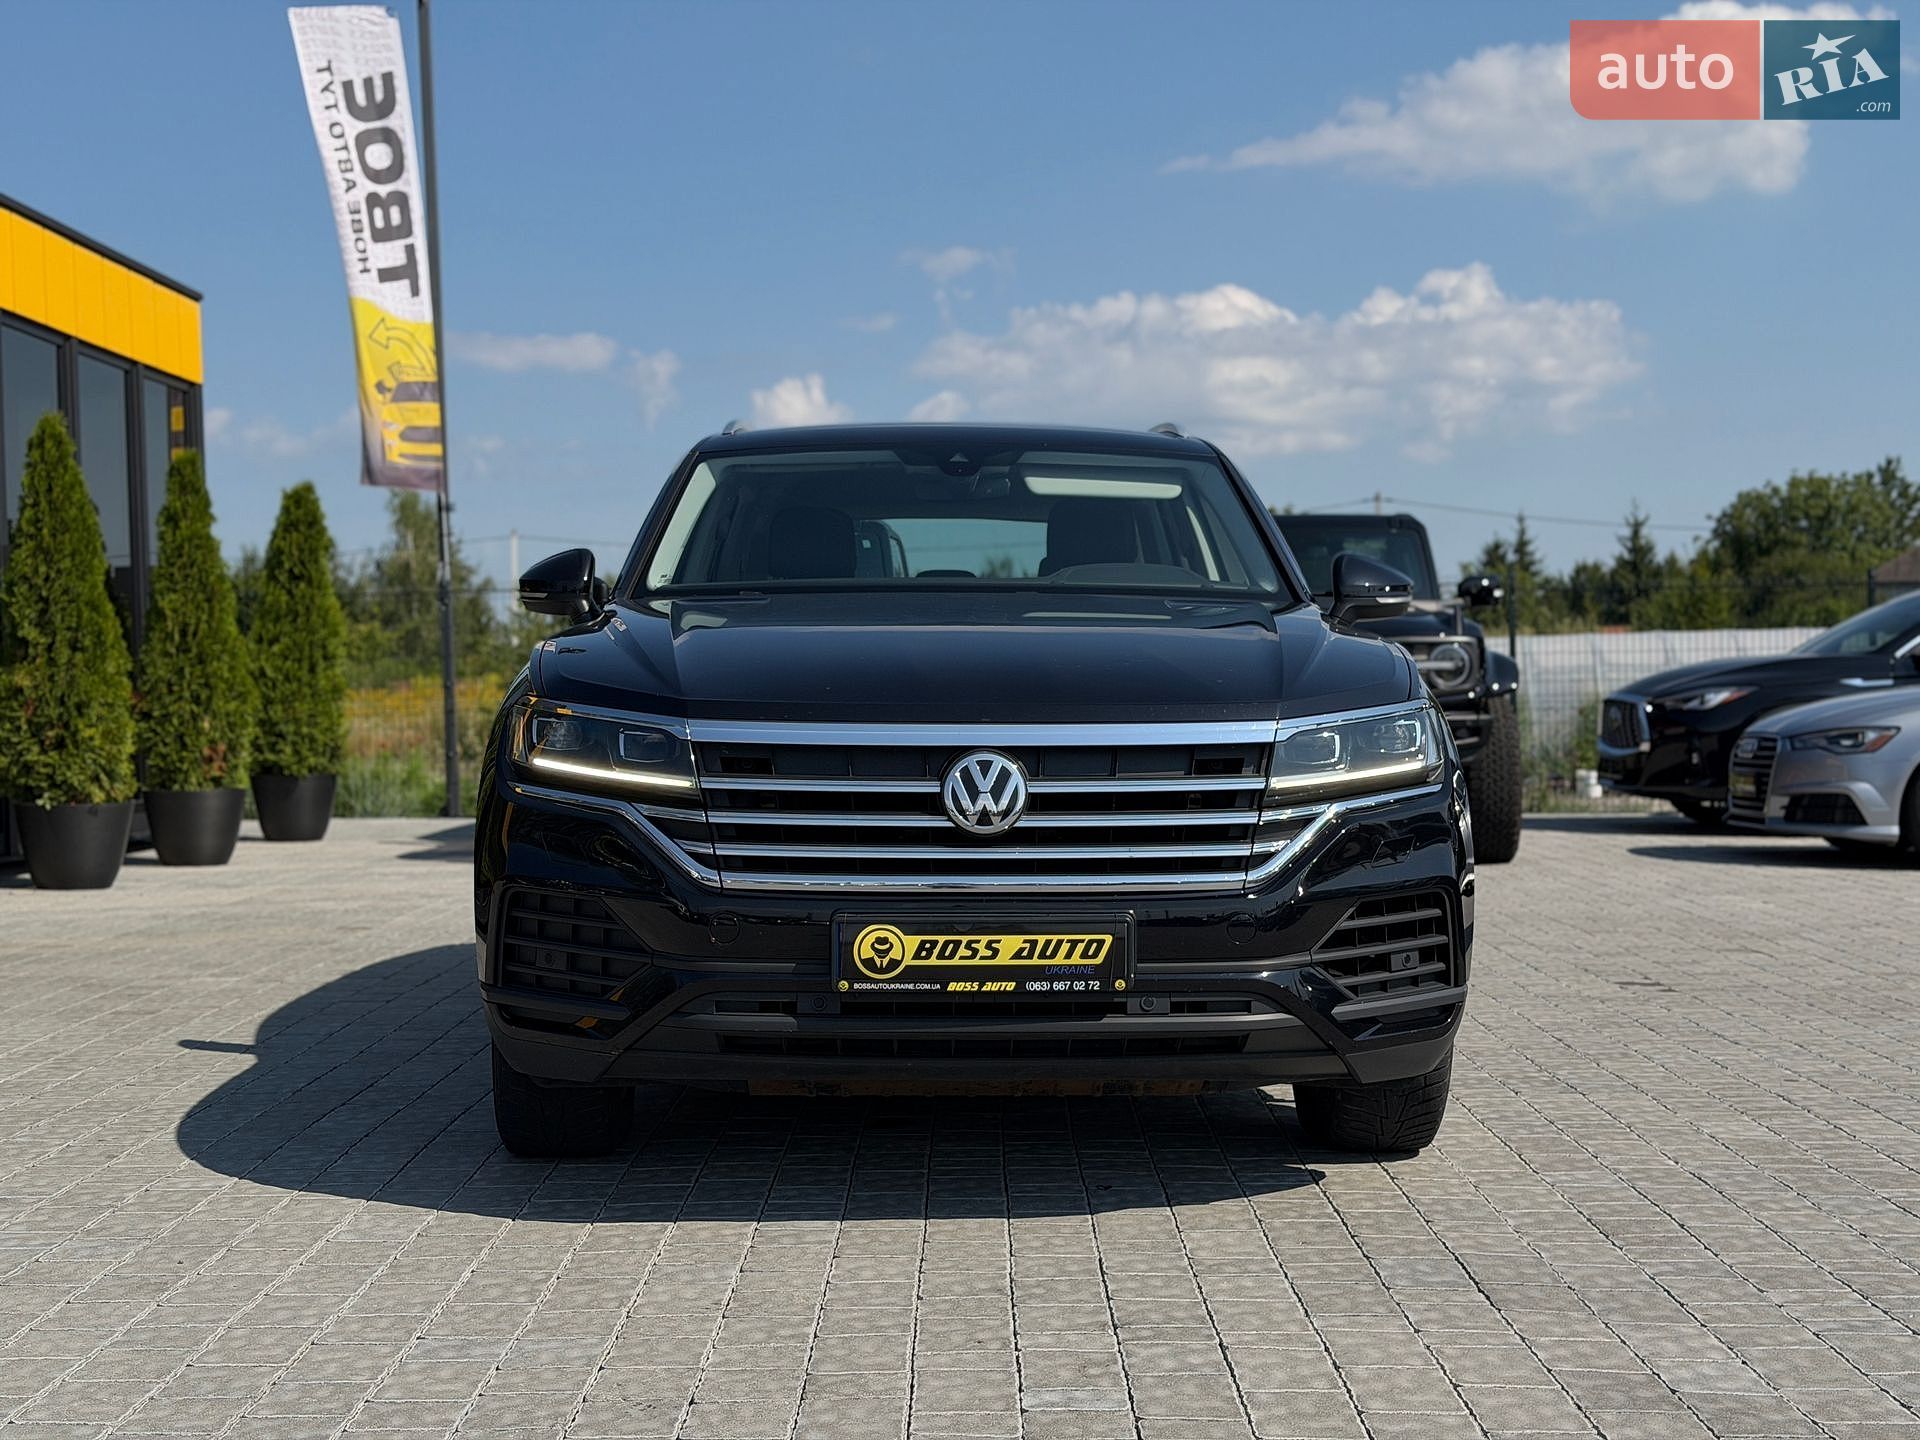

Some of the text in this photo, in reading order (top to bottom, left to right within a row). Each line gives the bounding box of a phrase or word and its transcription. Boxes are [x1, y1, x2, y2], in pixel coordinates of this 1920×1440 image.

[910, 938, 1108, 961] BOSS AUTO
[1045, 964, 1096, 975] UKRAINE
[853, 982, 941, 991] BOSSAUTOUKRAINE.COM.UA
[946, 981, 1017, 992] BOSS AUTO
[1025, 980, 1100, 992] (063) 667 02 72
